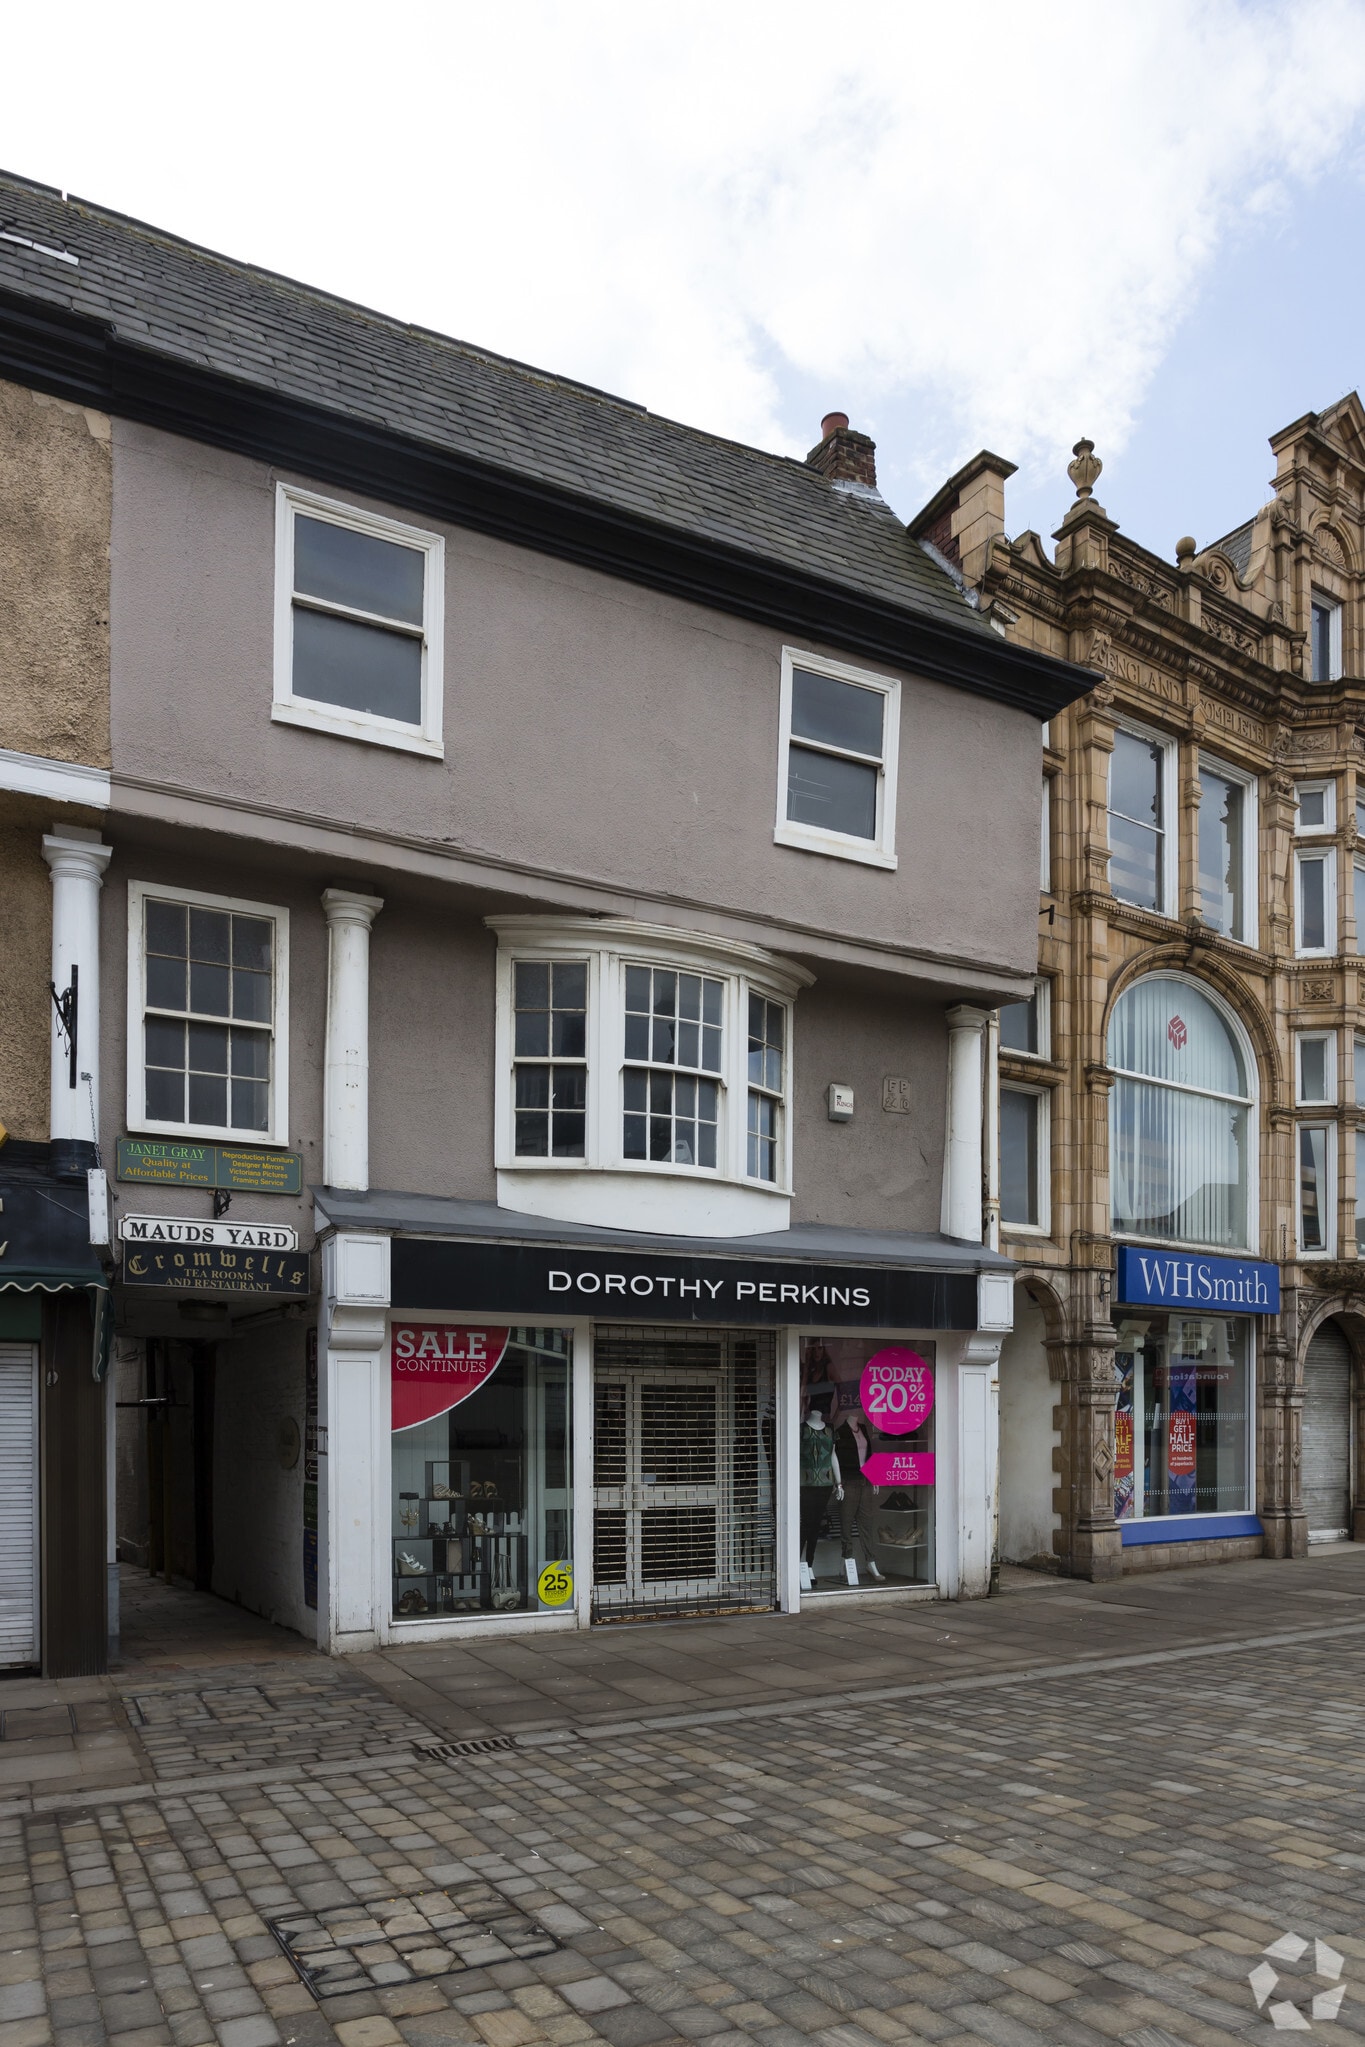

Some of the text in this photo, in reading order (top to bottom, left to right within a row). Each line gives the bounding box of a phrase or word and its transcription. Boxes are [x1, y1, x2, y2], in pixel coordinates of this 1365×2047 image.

[1107, 652, 1180, 702] ENGLAND
[127, 1143, 205, 1159] JANET GRAY
[142, 1157, 191, 1169] Quality at
[222, 1152, 294, 1164] Reproduction Furniture
[232, 1160, 285, 1171] Designer Mirrors
[124, 1167, 208, 1181] Affordable Prices
[229, 1168, 288, 1179] Victoriana Pictures
[232, 1176, 285, 1187] Framing Service
[129, 1222, 288, 1247] MAUDS YARD
[128, 1250, 305, 1285] Cromwells
[184, 1268, 254, 1281] TEA ROOMS
[1139, 1257, 1269, 1304] WHSmith
[166, 1277, 271, 1291] AND RESTAURANT
[548, 1270, 871, 1307] DOROTHY PERKINS
[396, 1329, 487, 1360] SALE
[396, 1359, 487, 1373] CONTINUES
[868, 1366, 926, 1382] TODAY
[868, 1383, 926, 1413] 20% OFF
[1116, 1426, 1124, 1434] ET
[1174, 1425, 1187, 1433] GET
[1115, 1434, 1132, 1446] ALF
[1169, 1433, 1195, 1444] HALF
[1171, 1444, 1193, 1453] PRICE
[892, 1457, 916, 1468] ALL
[886, 1470, 919, 1481] SHOES
[544, 1573, 568, 1591] 25
